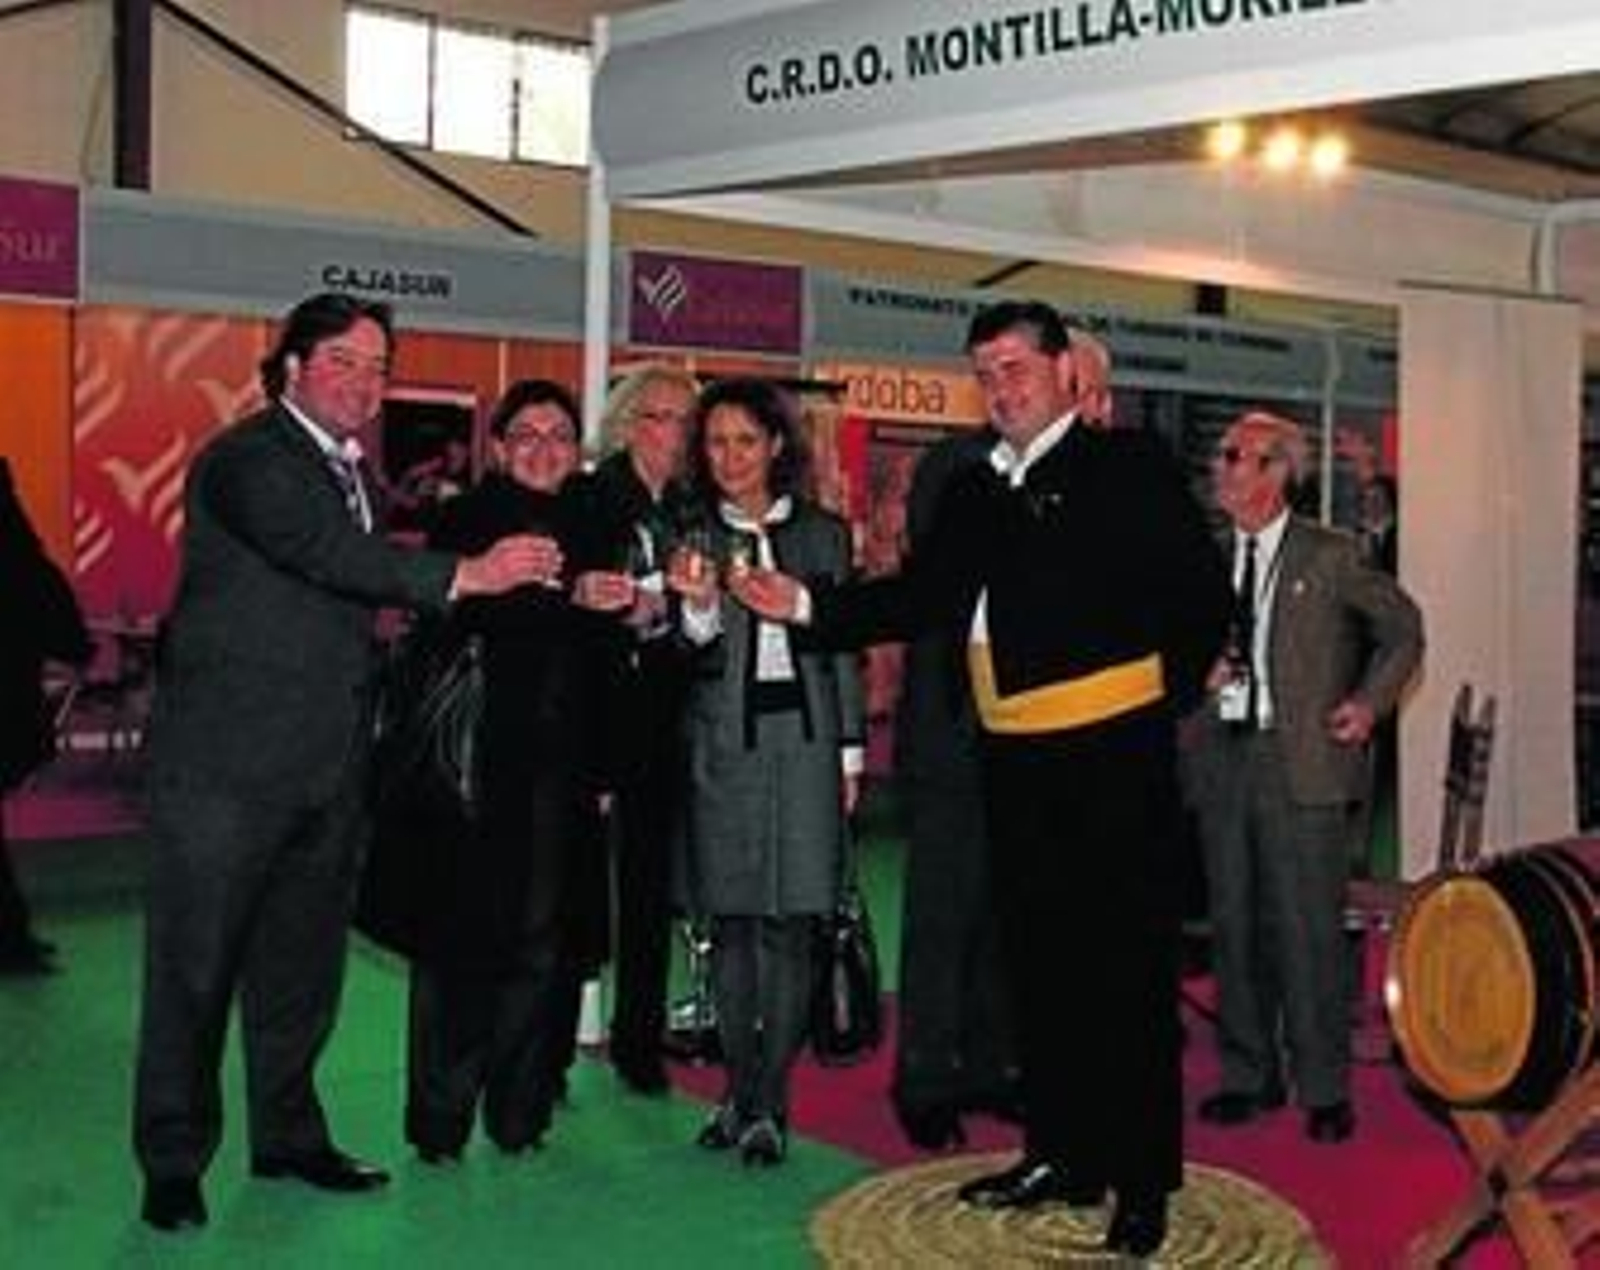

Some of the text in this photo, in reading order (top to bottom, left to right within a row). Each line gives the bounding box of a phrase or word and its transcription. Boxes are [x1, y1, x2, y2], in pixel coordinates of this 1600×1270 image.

[746, 0, 1368, 103] C.R.D.O. MONTILLA-MO
[844, 366, 945, 413] rdoba
